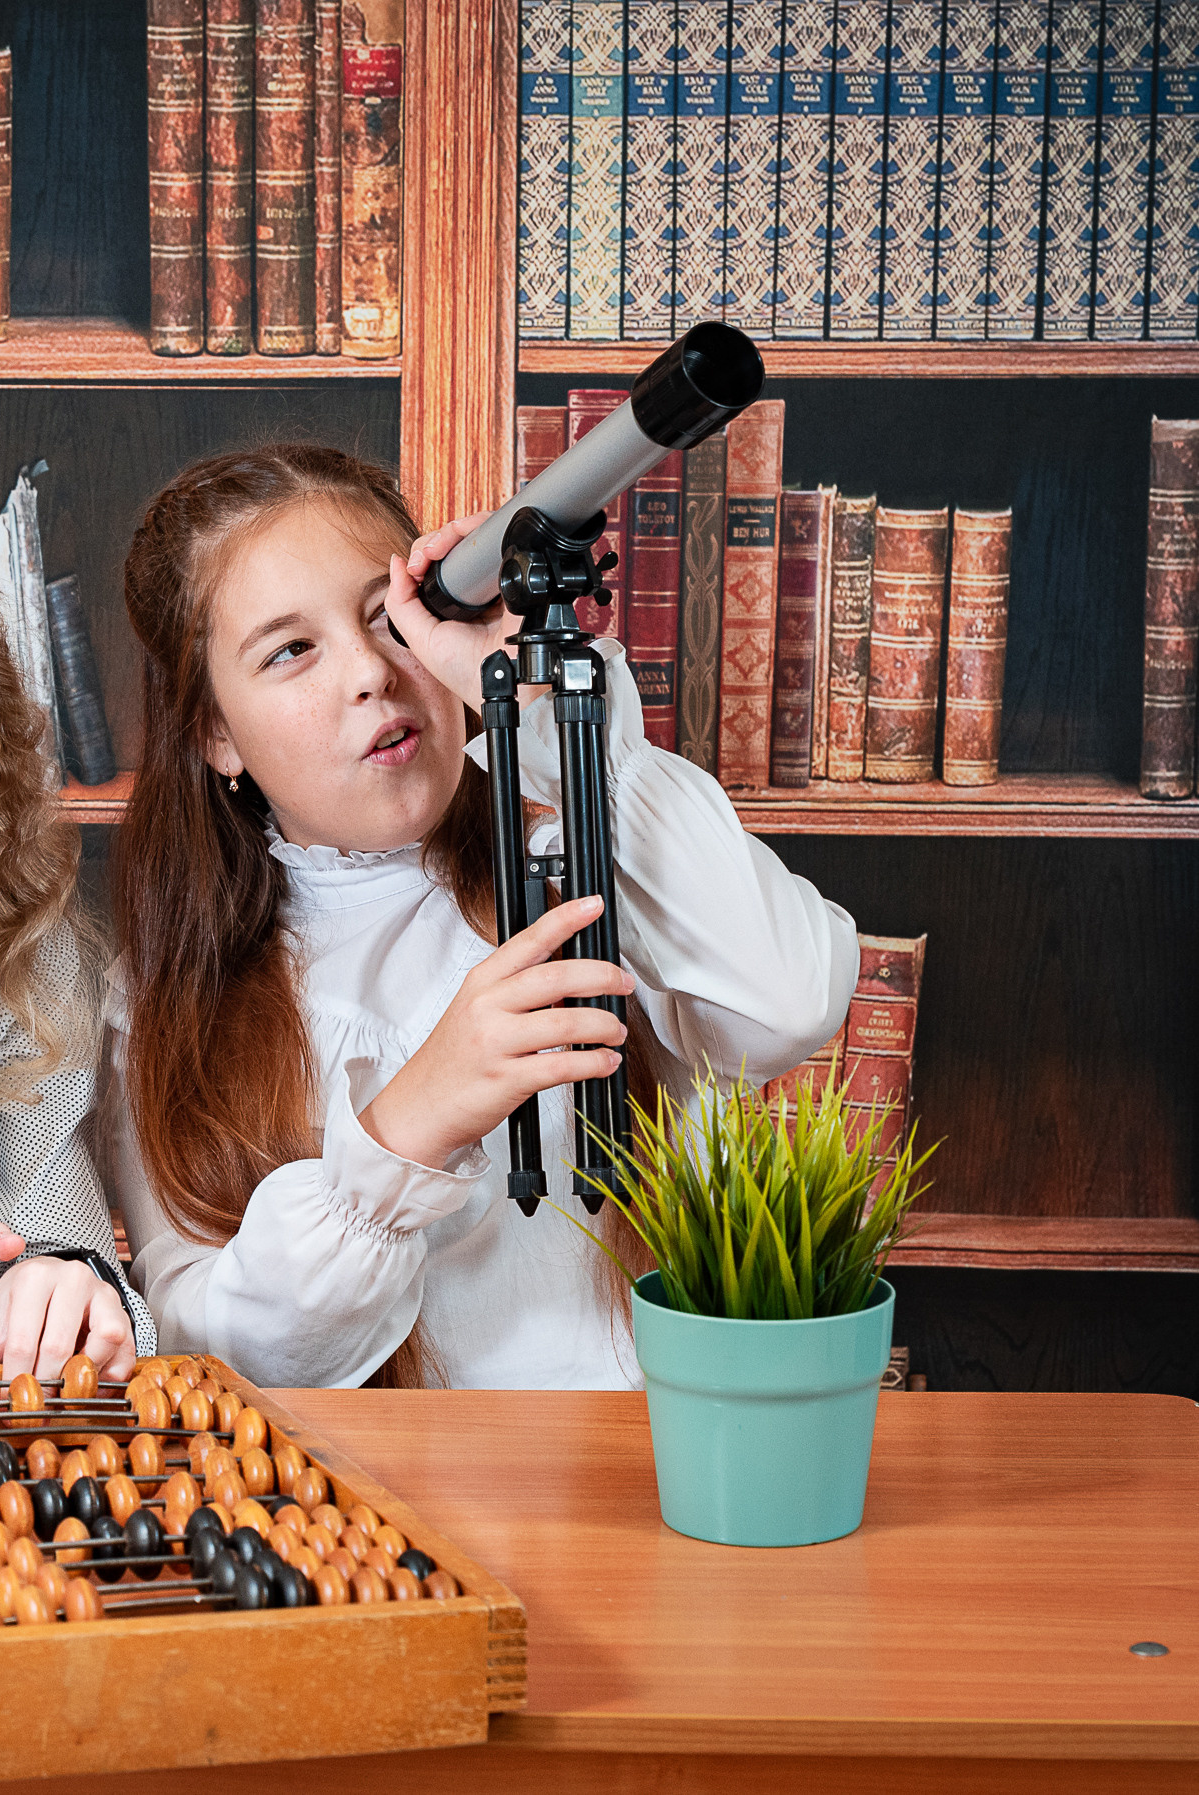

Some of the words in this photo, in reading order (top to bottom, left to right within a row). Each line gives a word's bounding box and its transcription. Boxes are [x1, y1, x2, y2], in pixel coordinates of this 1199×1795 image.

[647, 502, 667, 512] LEO
[637, 514, 675, 524] TOLSTOY
[732, 527, 749, 538] BEN
[753, 527, 770, 538] HUR
[637, 671, 667, 682] ANNA
